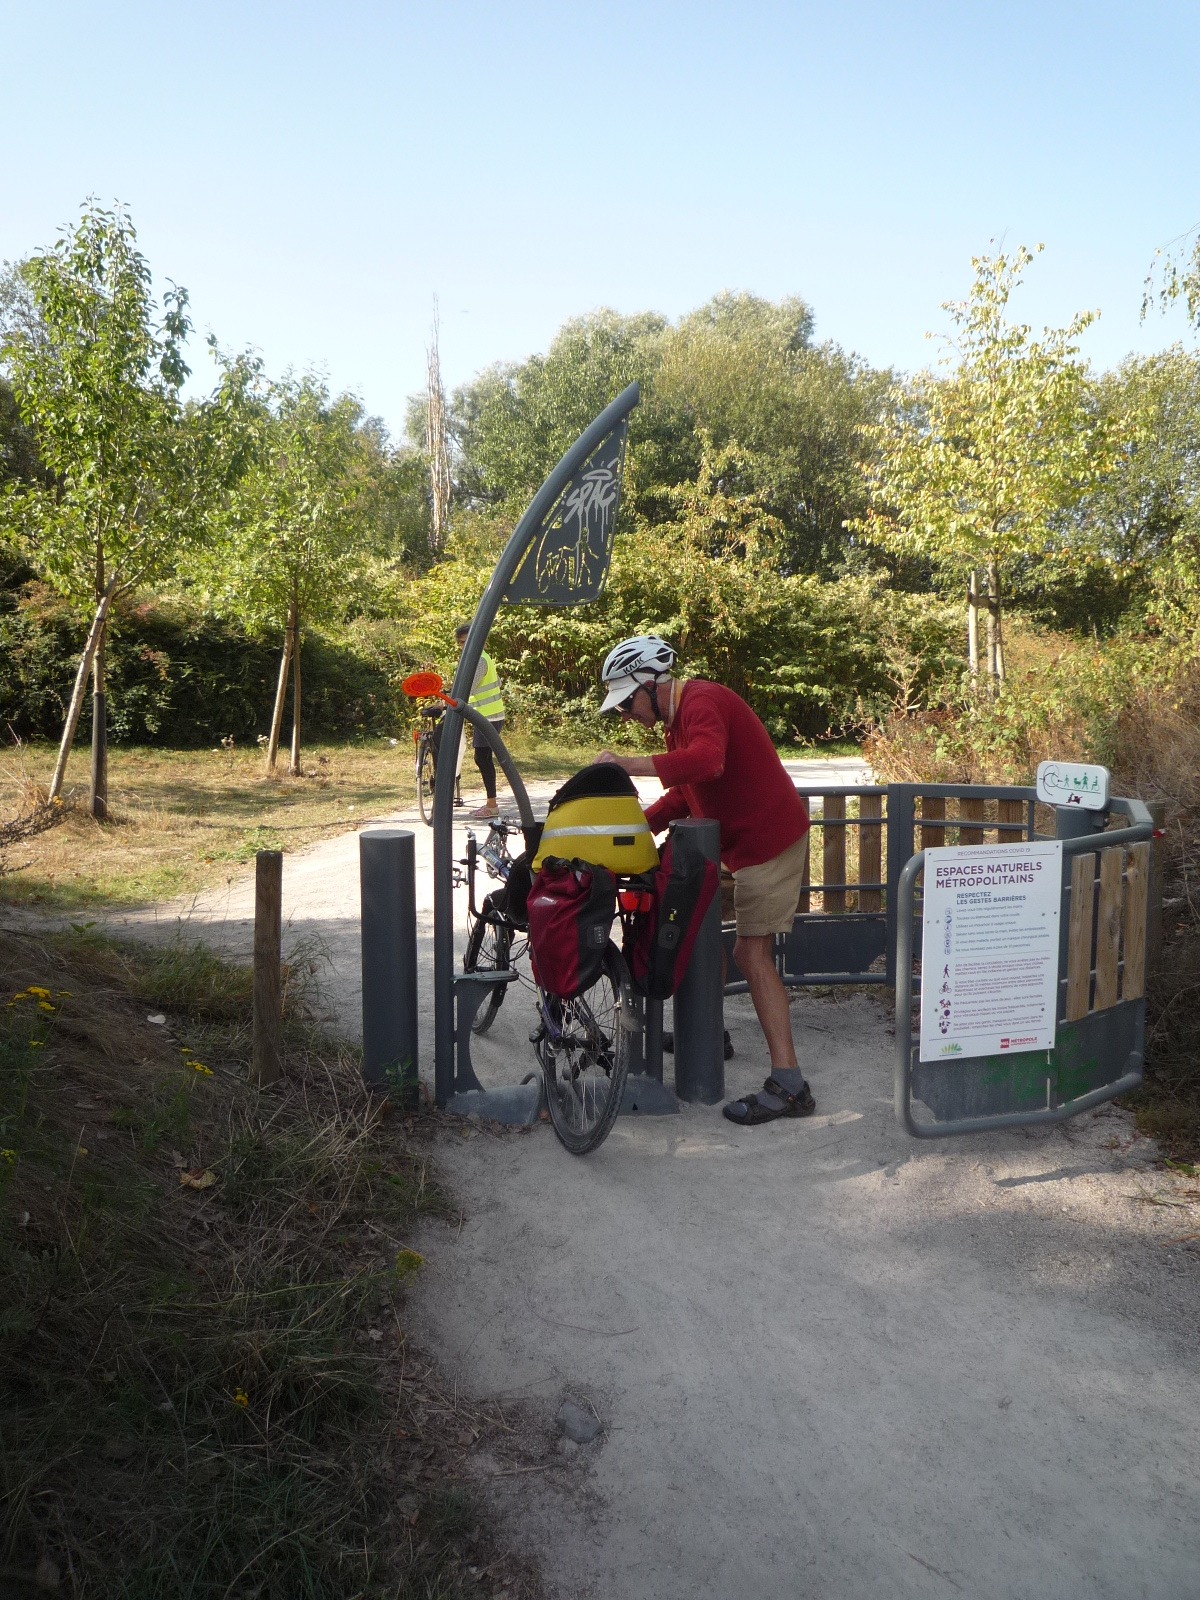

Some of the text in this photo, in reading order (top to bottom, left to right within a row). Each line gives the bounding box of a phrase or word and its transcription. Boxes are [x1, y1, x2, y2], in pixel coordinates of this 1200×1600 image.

[936, 861, 1043, 877] ESPACES NATURELS
[936, 873, 1034, 889] MÉTROPOLITAINS
[956, 891, 992, 899] RESPECTEZ
[993, 895, 1027, 903] BARRIÈRES
